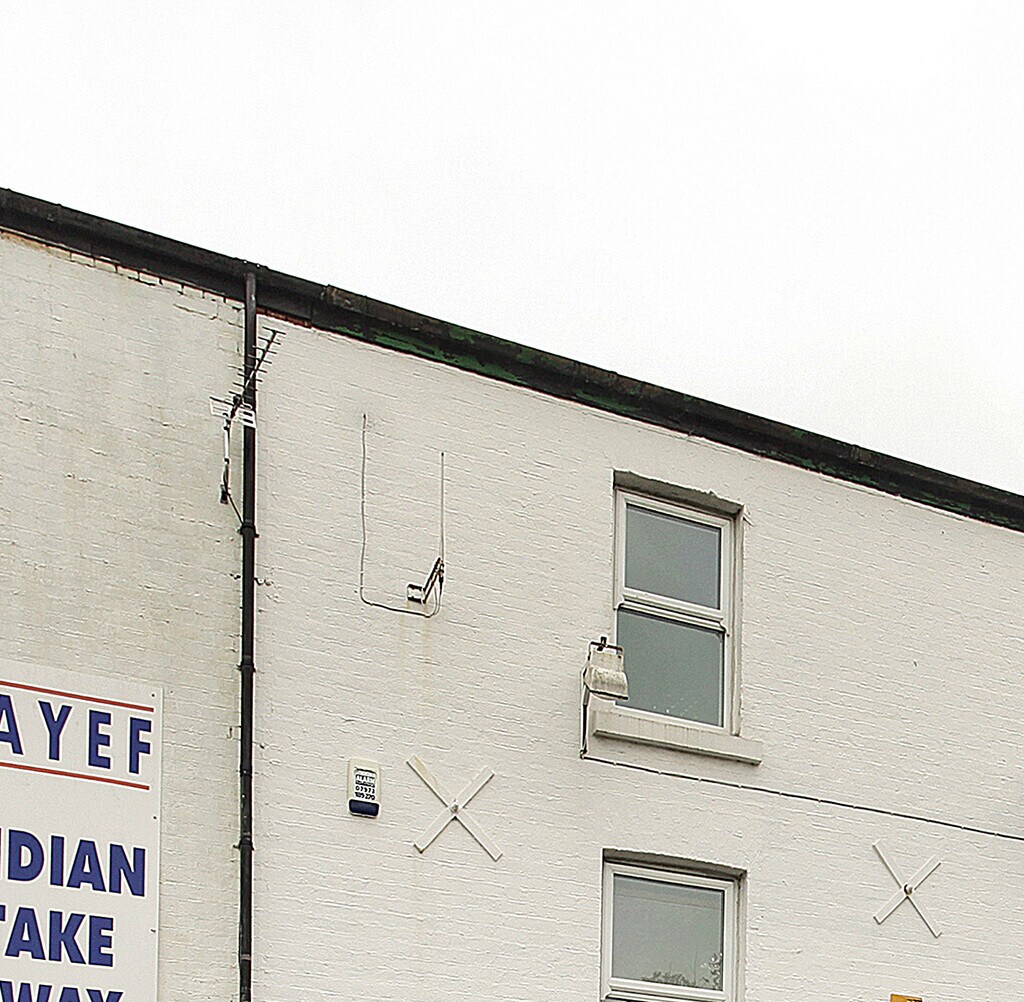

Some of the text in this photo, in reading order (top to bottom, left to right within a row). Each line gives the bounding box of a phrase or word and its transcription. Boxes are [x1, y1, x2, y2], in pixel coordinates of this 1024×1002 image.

[0, 694, 152, 774] AYEF
[0, 827, 147, 898] DIAN
[0, 904, 115, 968] AKE
